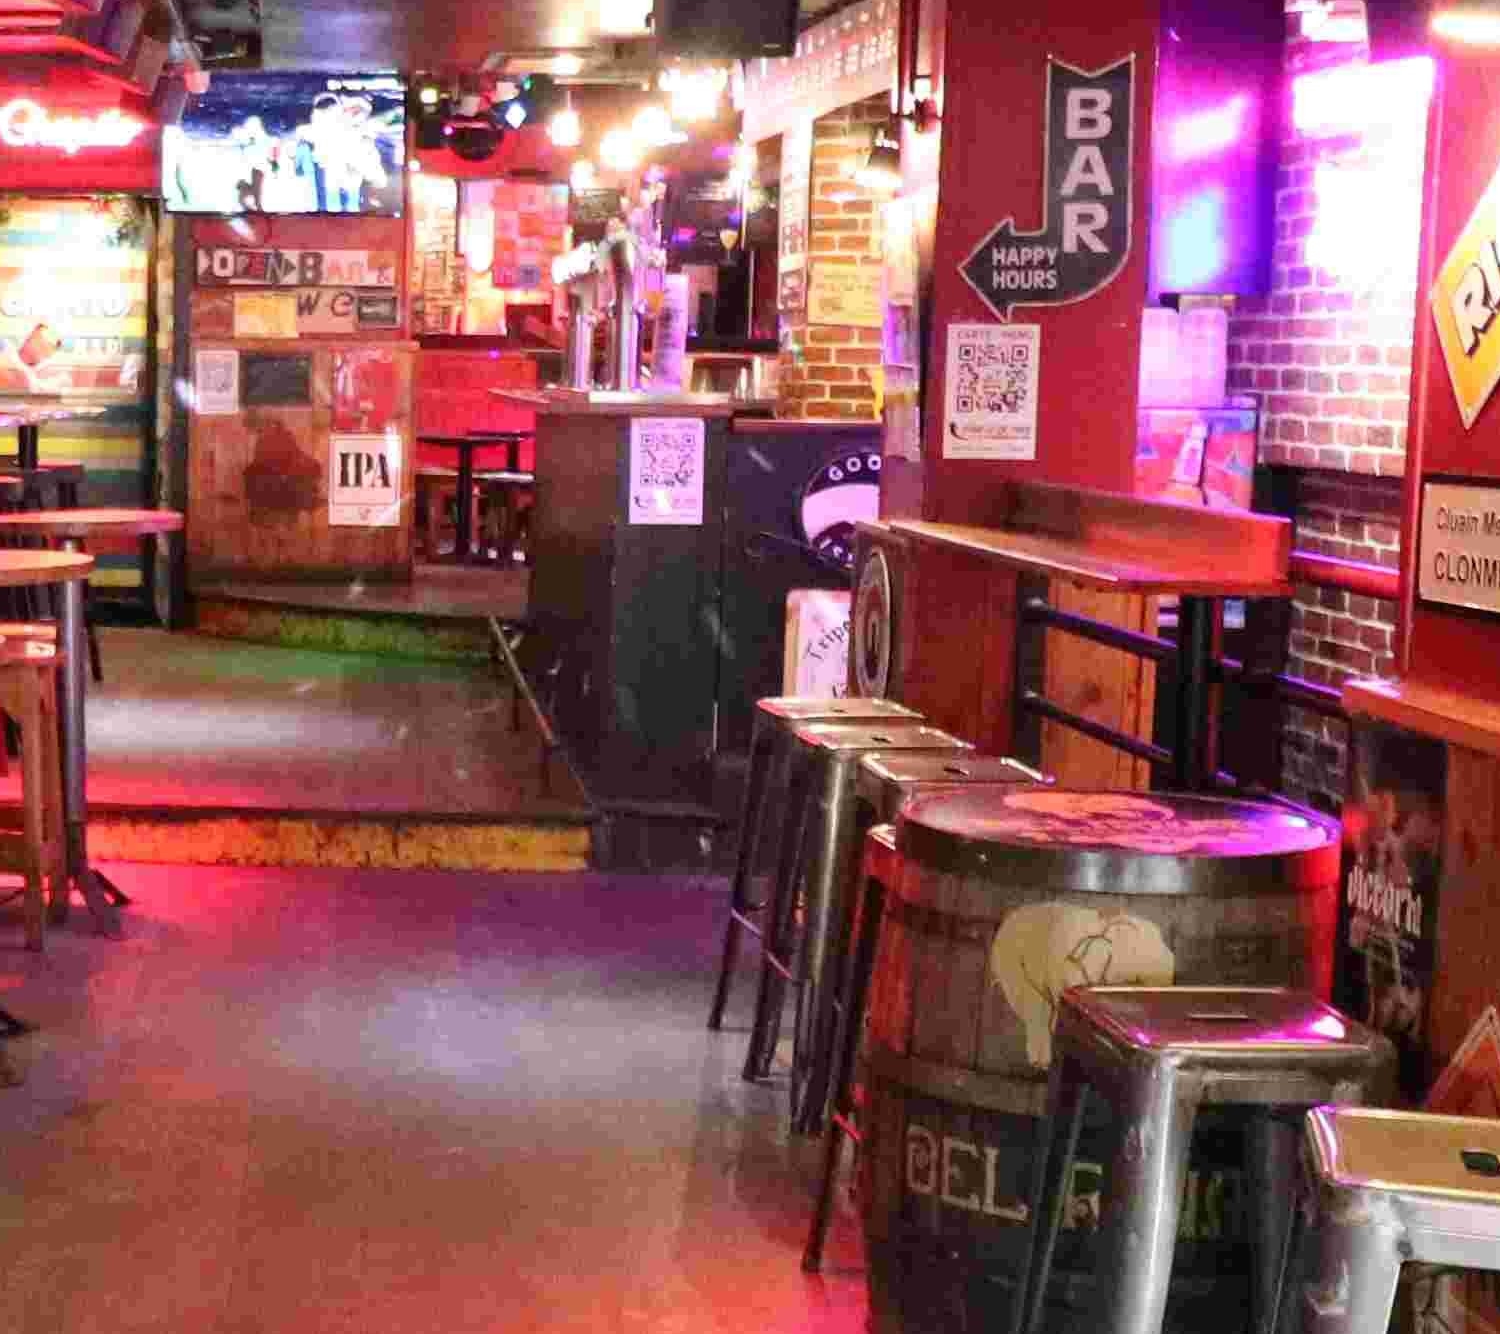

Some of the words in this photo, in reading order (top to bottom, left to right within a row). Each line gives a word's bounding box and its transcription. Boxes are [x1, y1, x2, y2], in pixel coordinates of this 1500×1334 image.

[1059, 87, 1114, 254] BAR
[991, 247, 1058, 267] HAPPY
[991, 269, 1058, 291] HOURS
[338, 451, 392, 489] IPA
[1436, 505, 1480, 536] Cluain
